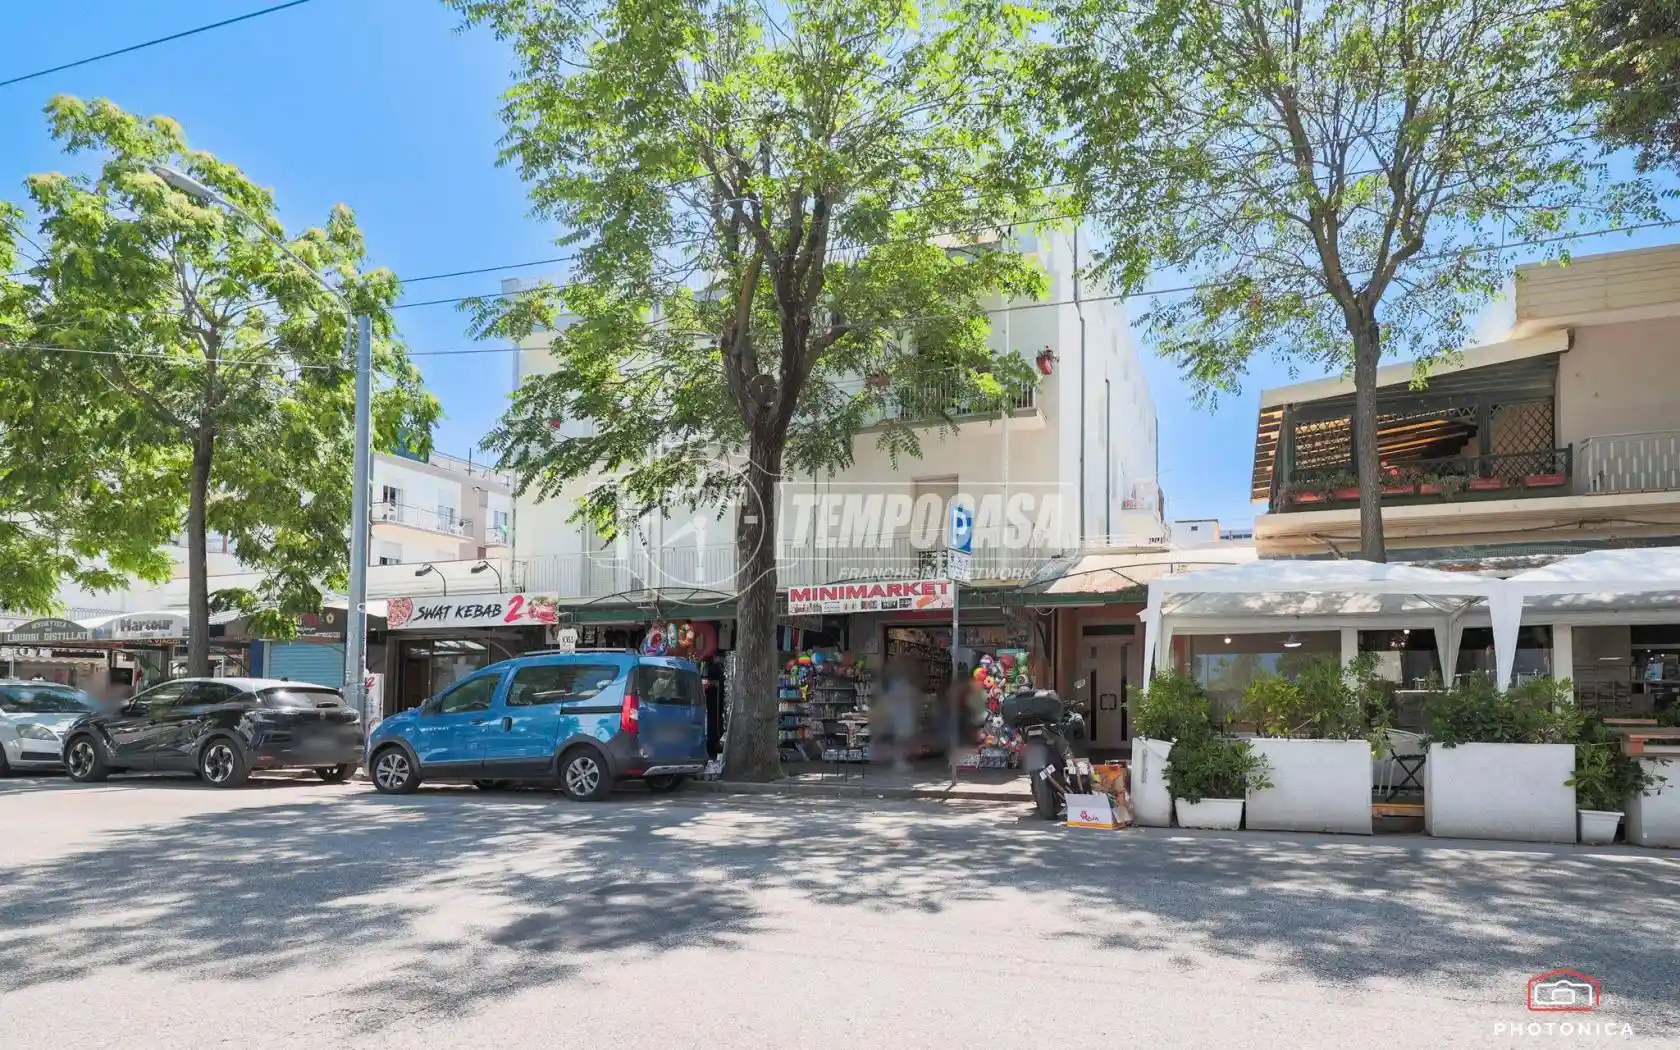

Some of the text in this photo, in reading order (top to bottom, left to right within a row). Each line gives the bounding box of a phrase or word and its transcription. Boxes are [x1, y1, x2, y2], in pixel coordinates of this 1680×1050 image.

[952, 507, 968, 546] P
[789, 581, 952, 602] MINIMARKET
[413, 594, 526, 624] SWAT KEBAB 2
